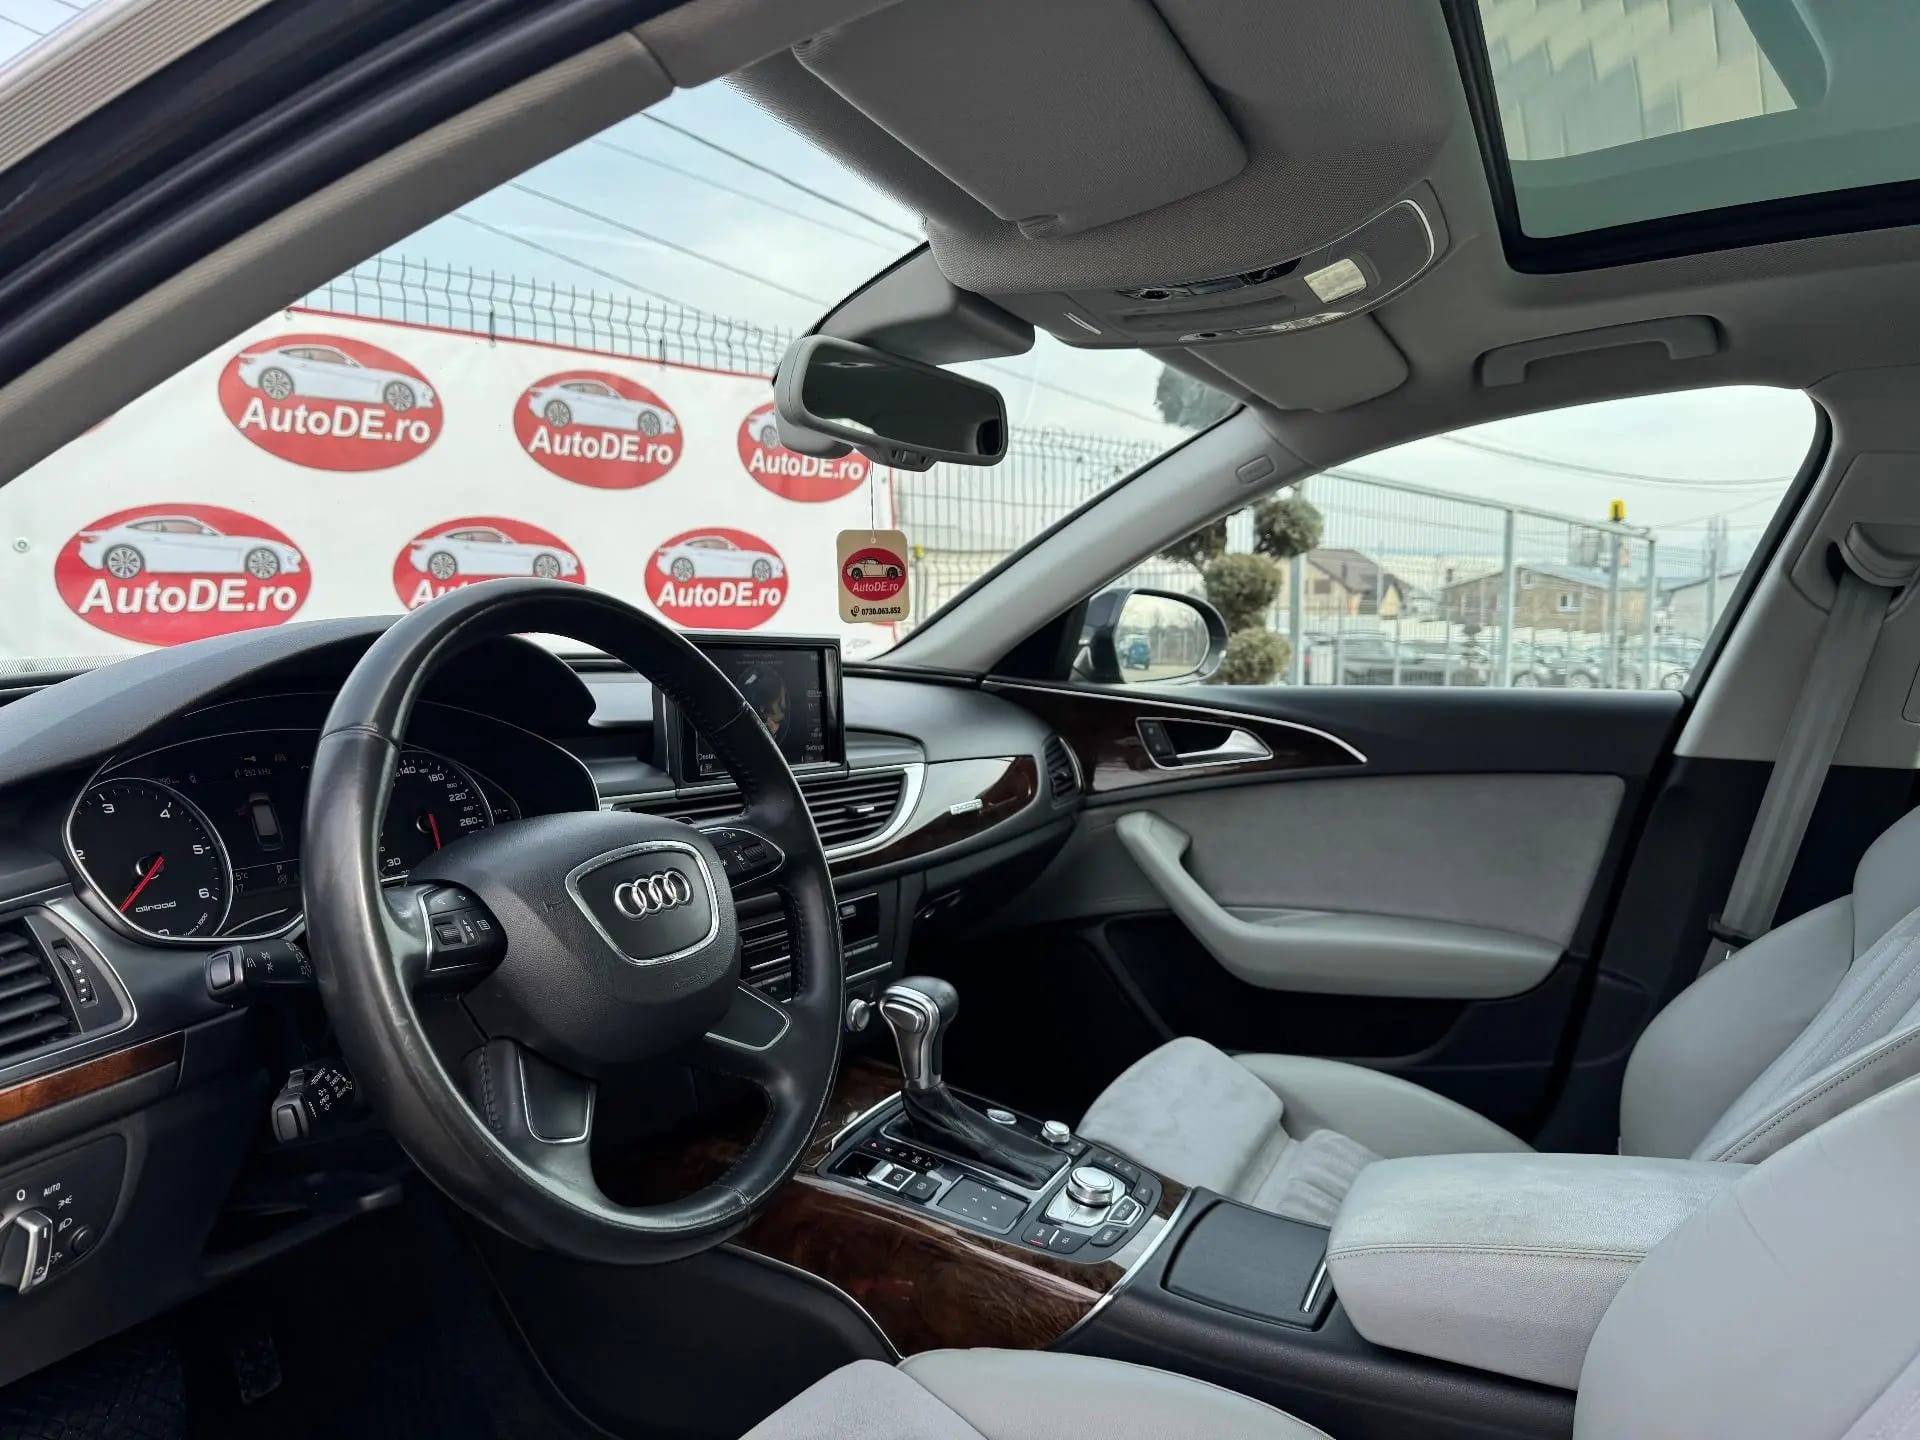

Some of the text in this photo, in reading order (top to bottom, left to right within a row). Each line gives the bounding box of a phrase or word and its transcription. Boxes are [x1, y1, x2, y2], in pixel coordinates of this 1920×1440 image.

[239, 397, 431, 444] AutoDE.ro
[528, 425, 673, 465] AutoDE.ro
[748, 448, 864, 480] AutoDE.ro
[852, 581, 899, 592] AutoDE.ro
[80, 578, 298, 614] AutoDE.ro
[656, 581, 781, 607] AutoDE.ro
[400, 766, 416, 775] 140
[428, 773, 445, 783] 180
[448, 792, 467, 802] 220
[102, 803, 115, 814] 3
[159, 809, 171, 819] 4
[460, 816, 478, 827] 260
[192, 844, 204, 855] 5
[198, 888, 210, 899] 6
[135, 900, 177, 913] allroad
[43, 1182, 61, 1197] AUTO
